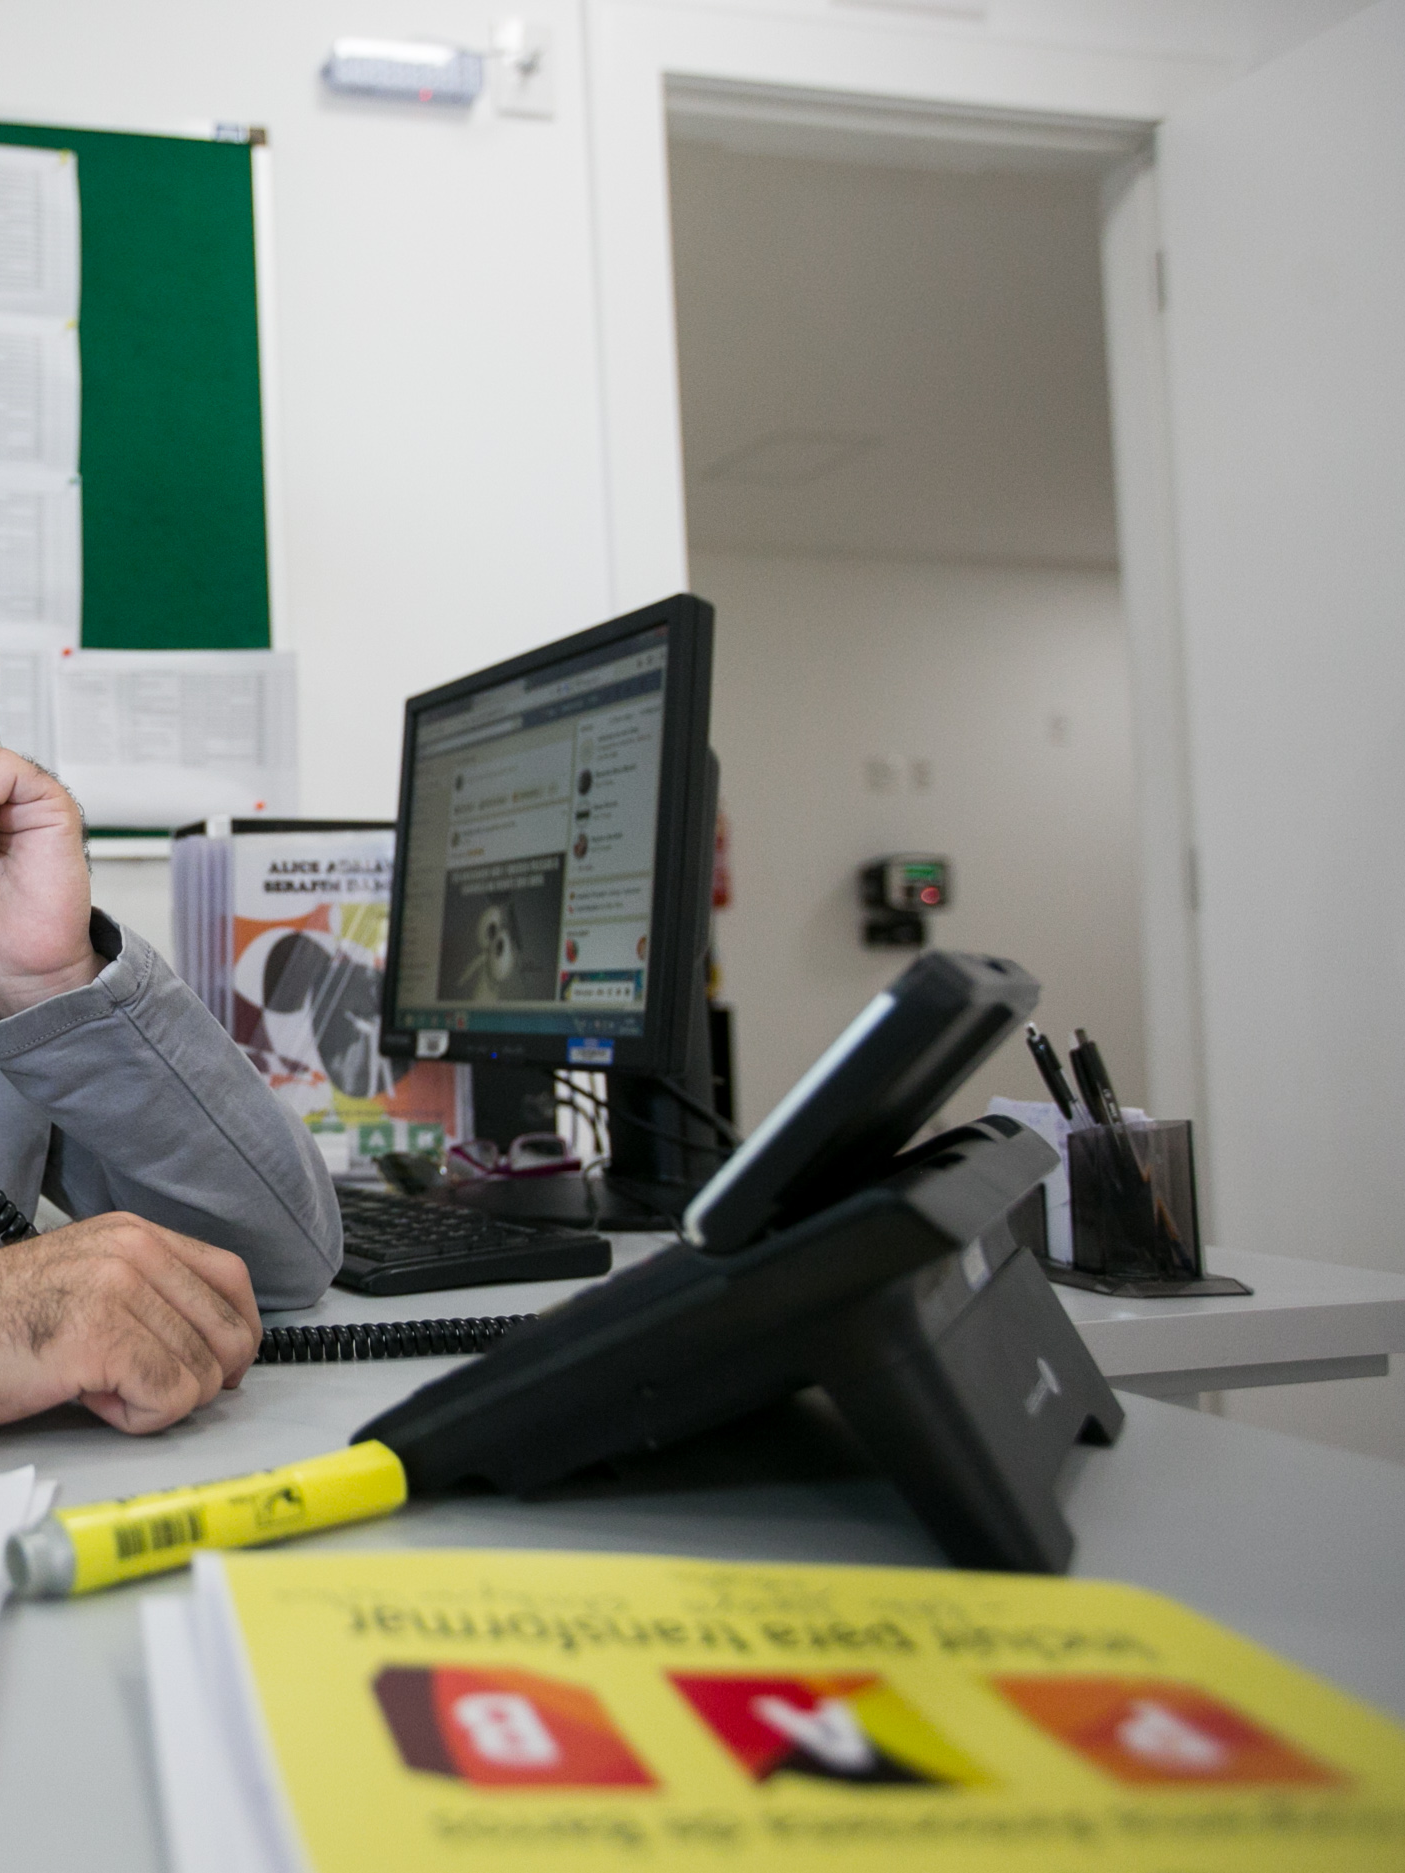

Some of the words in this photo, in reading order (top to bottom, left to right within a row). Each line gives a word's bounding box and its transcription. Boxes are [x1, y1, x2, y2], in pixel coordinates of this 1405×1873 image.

[347, 1602, 753, 1656] transformar
[761, 1615, 916, 1658] para
[455, 1692, 560, 1766] B
